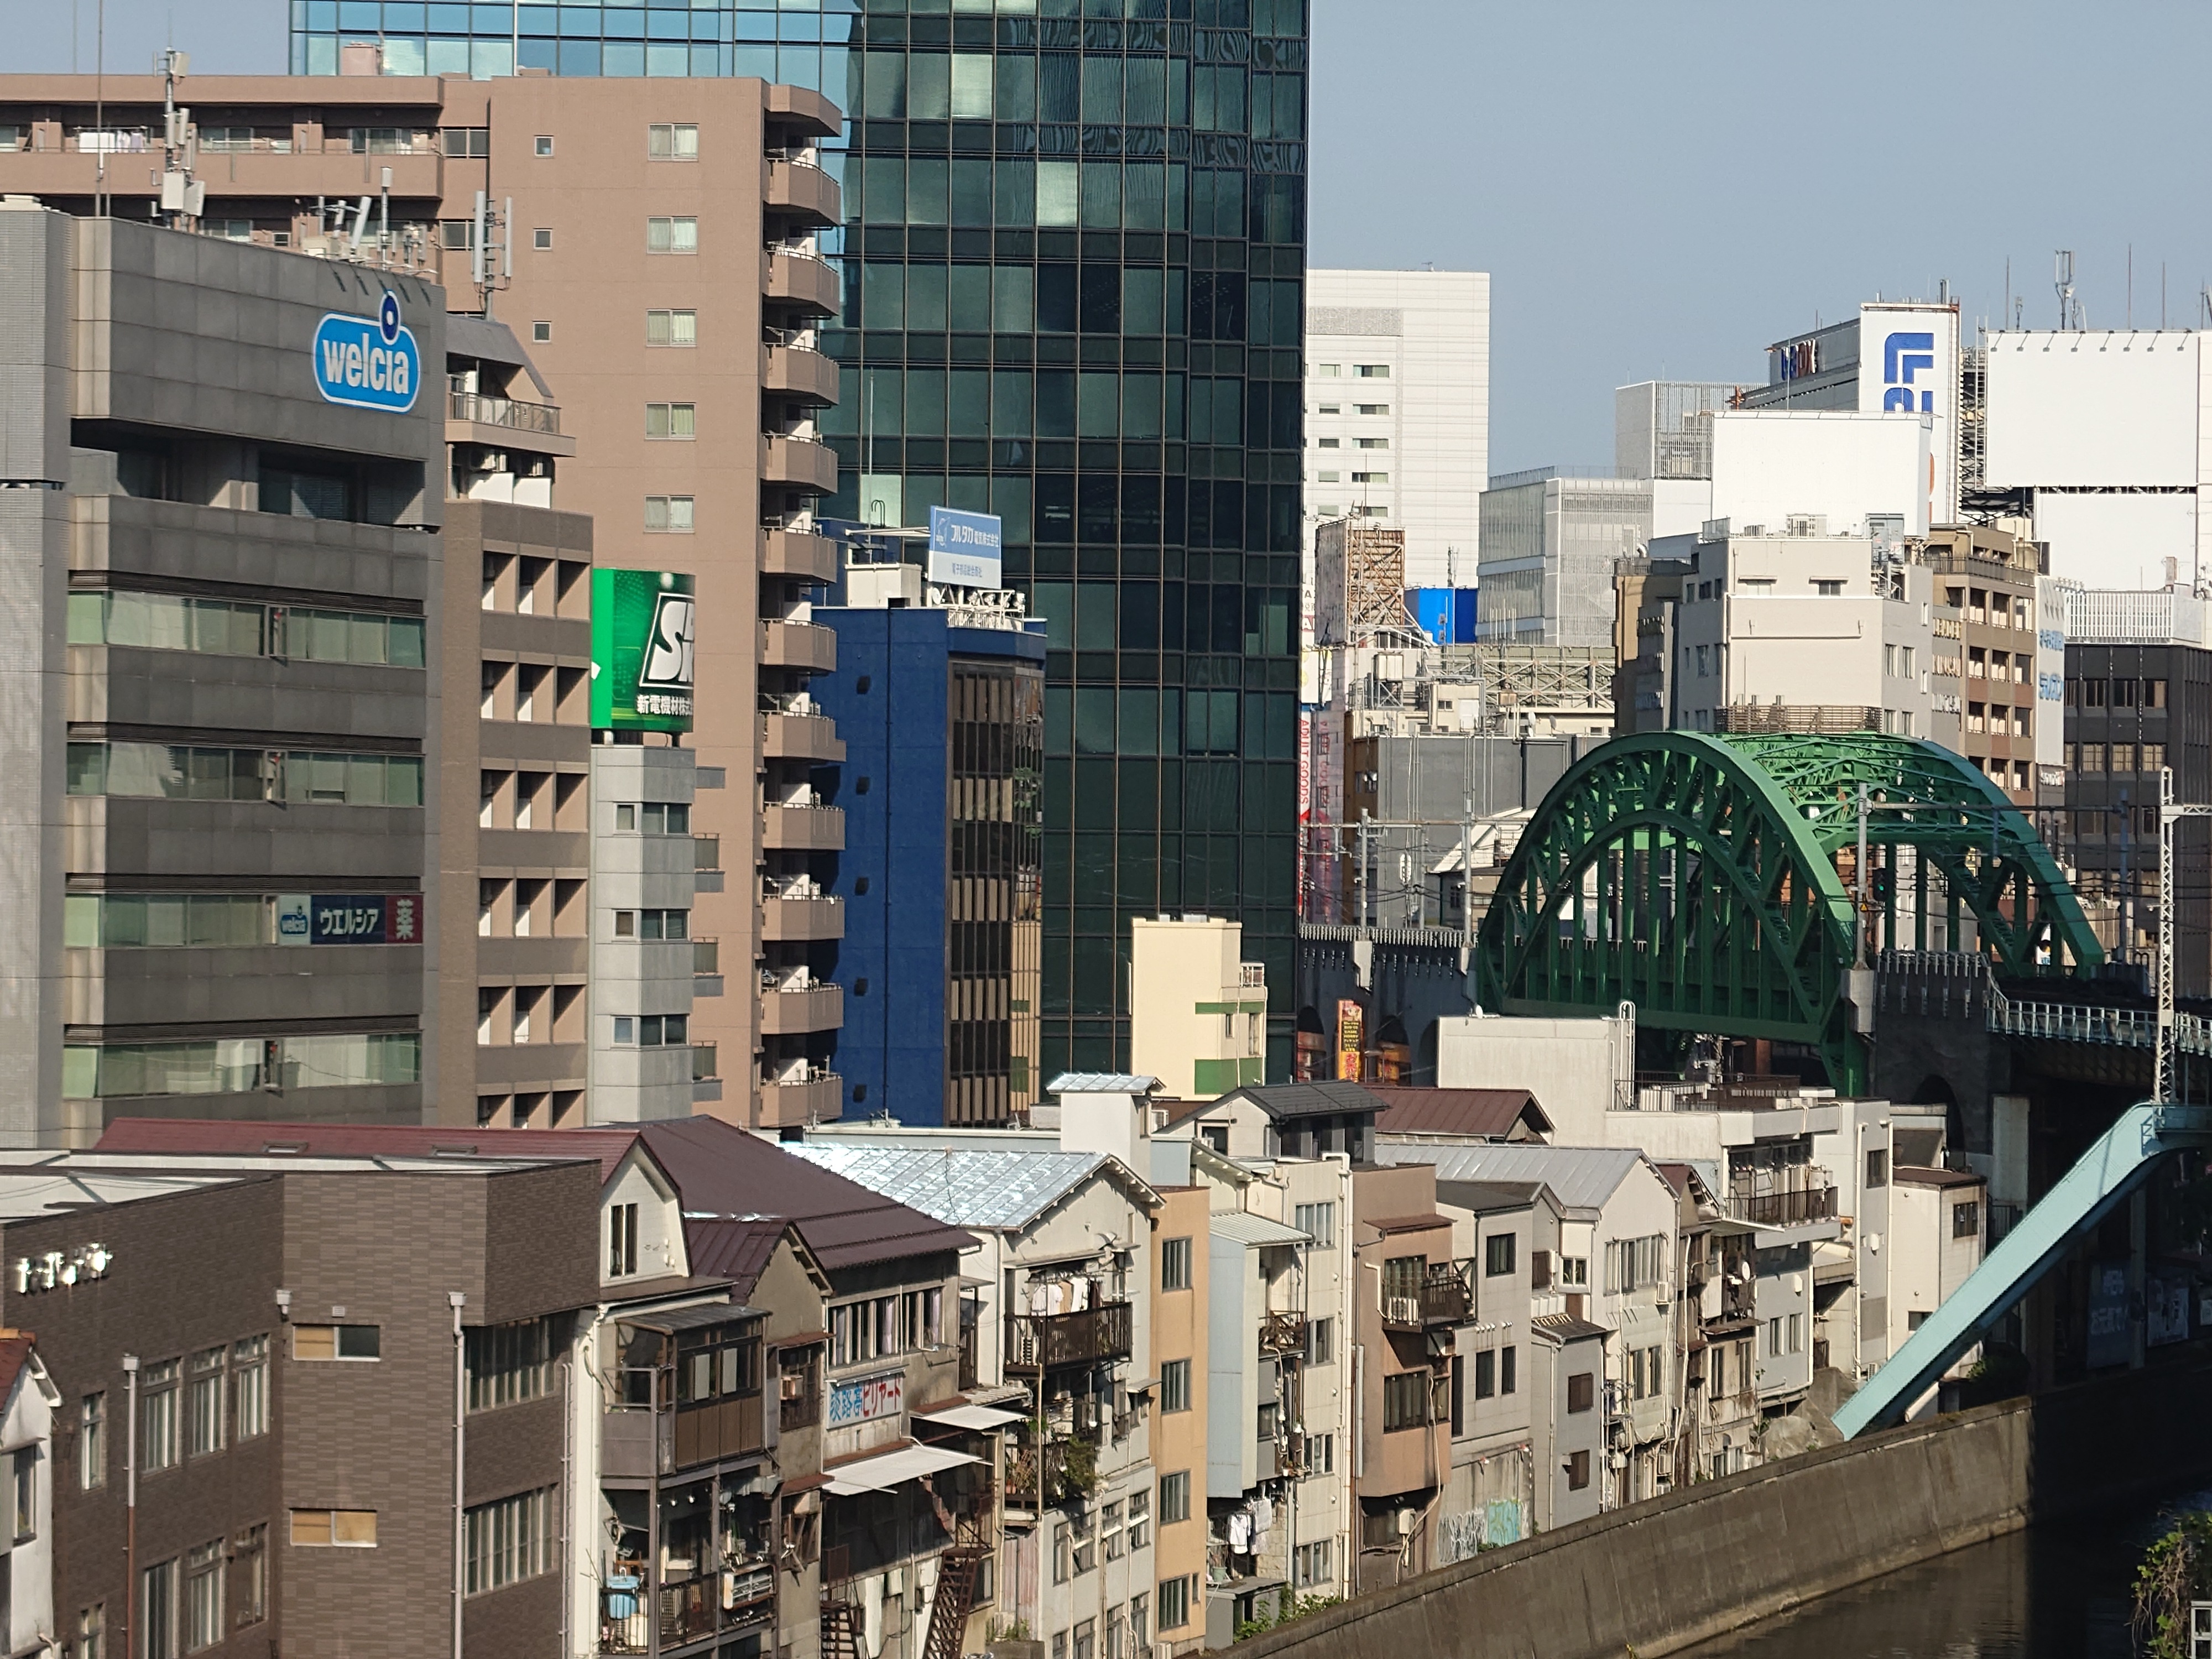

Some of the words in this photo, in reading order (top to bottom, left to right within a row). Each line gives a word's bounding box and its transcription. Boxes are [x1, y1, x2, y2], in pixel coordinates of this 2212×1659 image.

[322, 332, 409, 394] welcia
[1300, 760, 1309, 805] GOODS
[320, 908, 379, 936] ウエルシア
[395, 899, 415, 941] 薬
